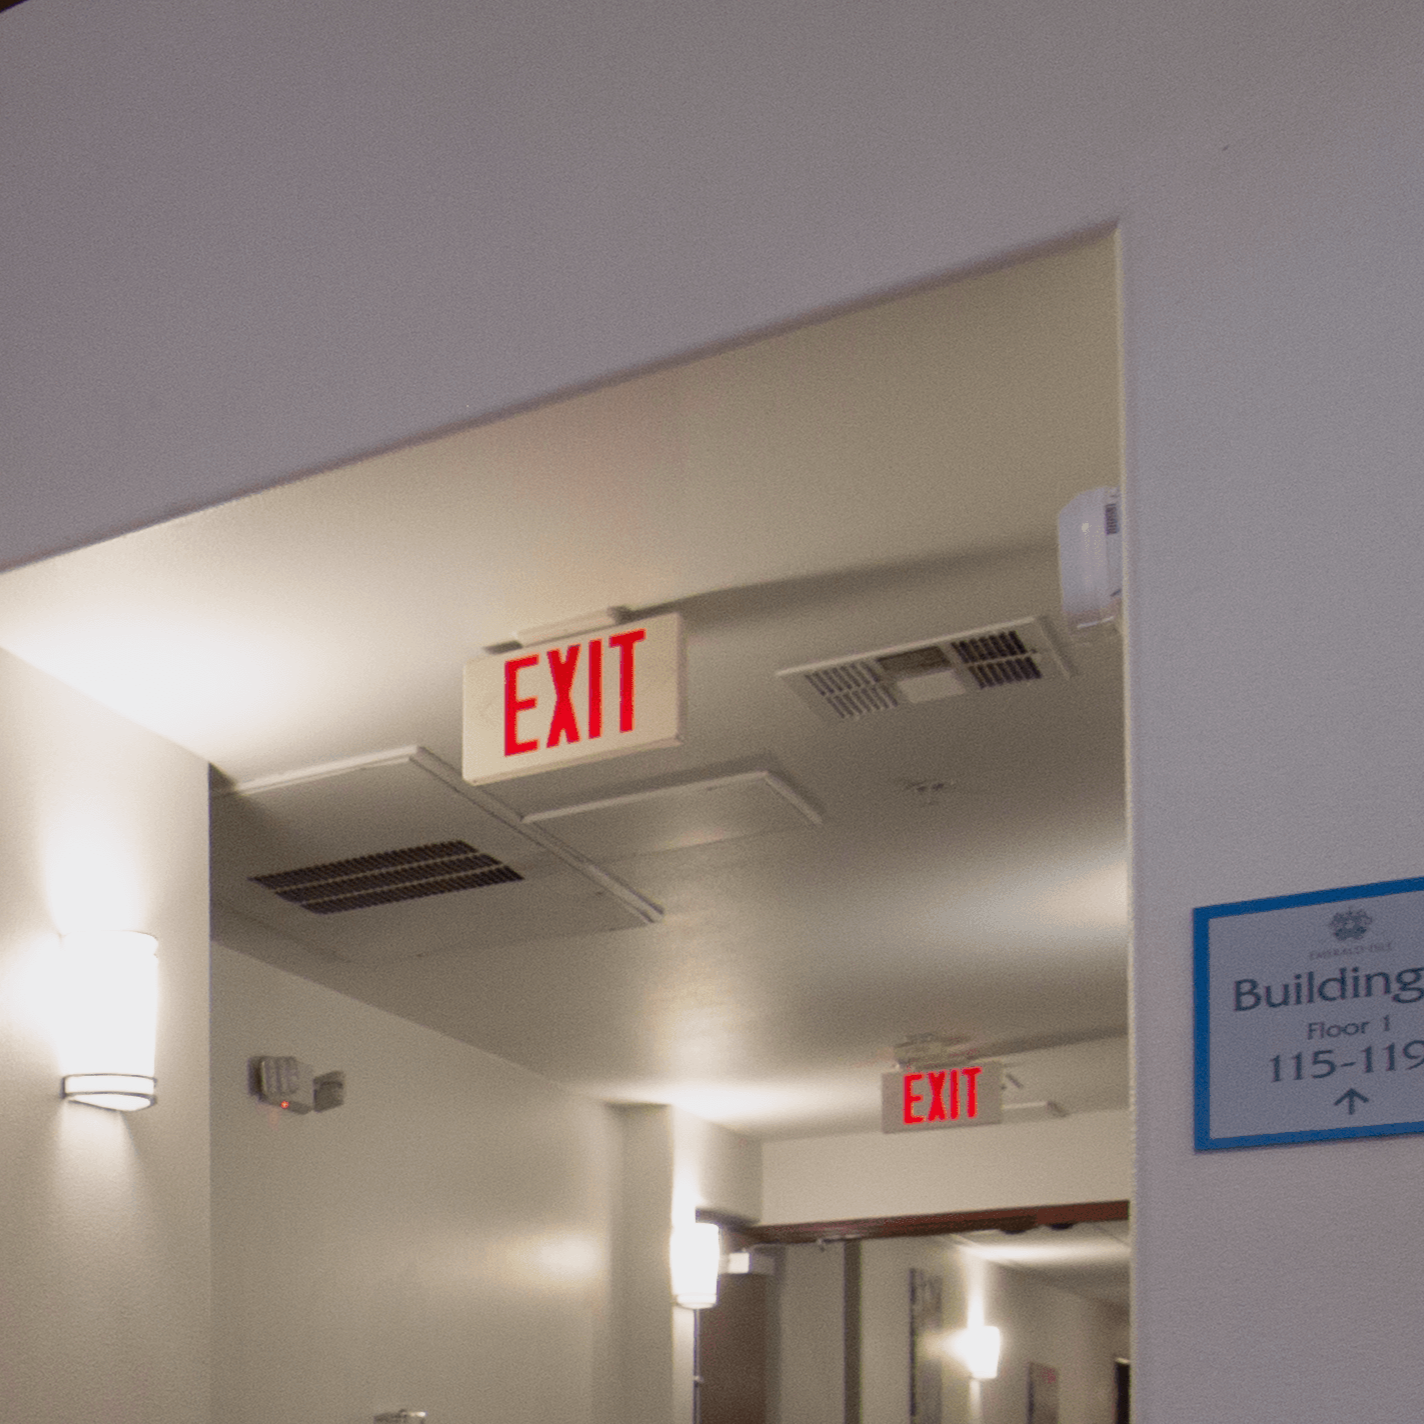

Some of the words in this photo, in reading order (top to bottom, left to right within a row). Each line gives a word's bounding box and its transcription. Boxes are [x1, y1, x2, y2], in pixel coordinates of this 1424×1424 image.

[504, 628, 647, 757] EXIT
[1233, 966, 1424, 1012] Building
[1307, 1021, 1370, 1040] Floor
[1382, 1014, 1391, 1032] 1
[1269, 1039, 1424, 1083] 115-119
[903, 1066, 983, 1125] EXIT
